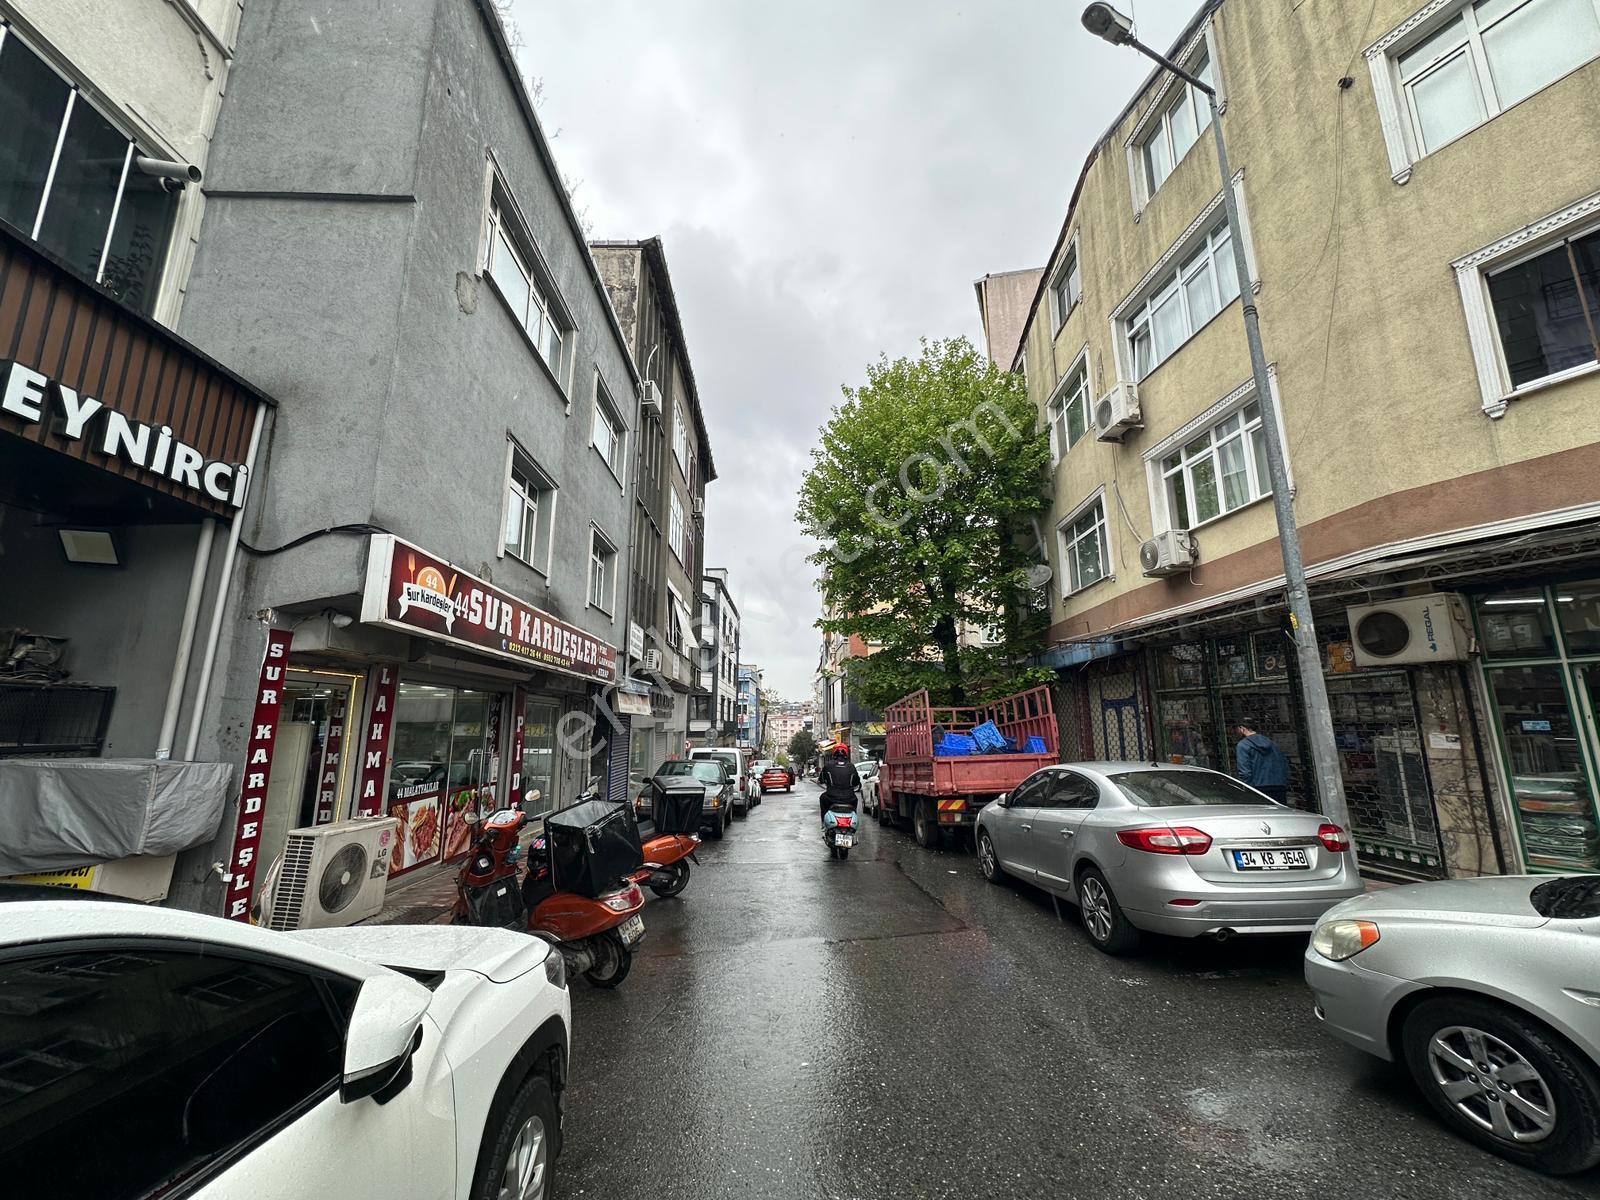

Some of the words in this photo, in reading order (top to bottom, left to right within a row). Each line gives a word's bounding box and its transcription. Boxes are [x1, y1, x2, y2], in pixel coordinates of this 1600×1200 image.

[426, 574, 438, 590] 44
[407, 587, 420, 602] Sur
[420, 589, 451, 613] Kardeşler
[1422, 606, 1436, 642] REGAL
[518, 610, 597, 666] KARDEŞLER
[261, 643, 284, 705] SUR
[378, 848, 387, 858] LG
[1242, 851, 1257, 866] 34
[1260, 851, 1275, 865] KB
[1280, 851, 1306, 865] 3648
